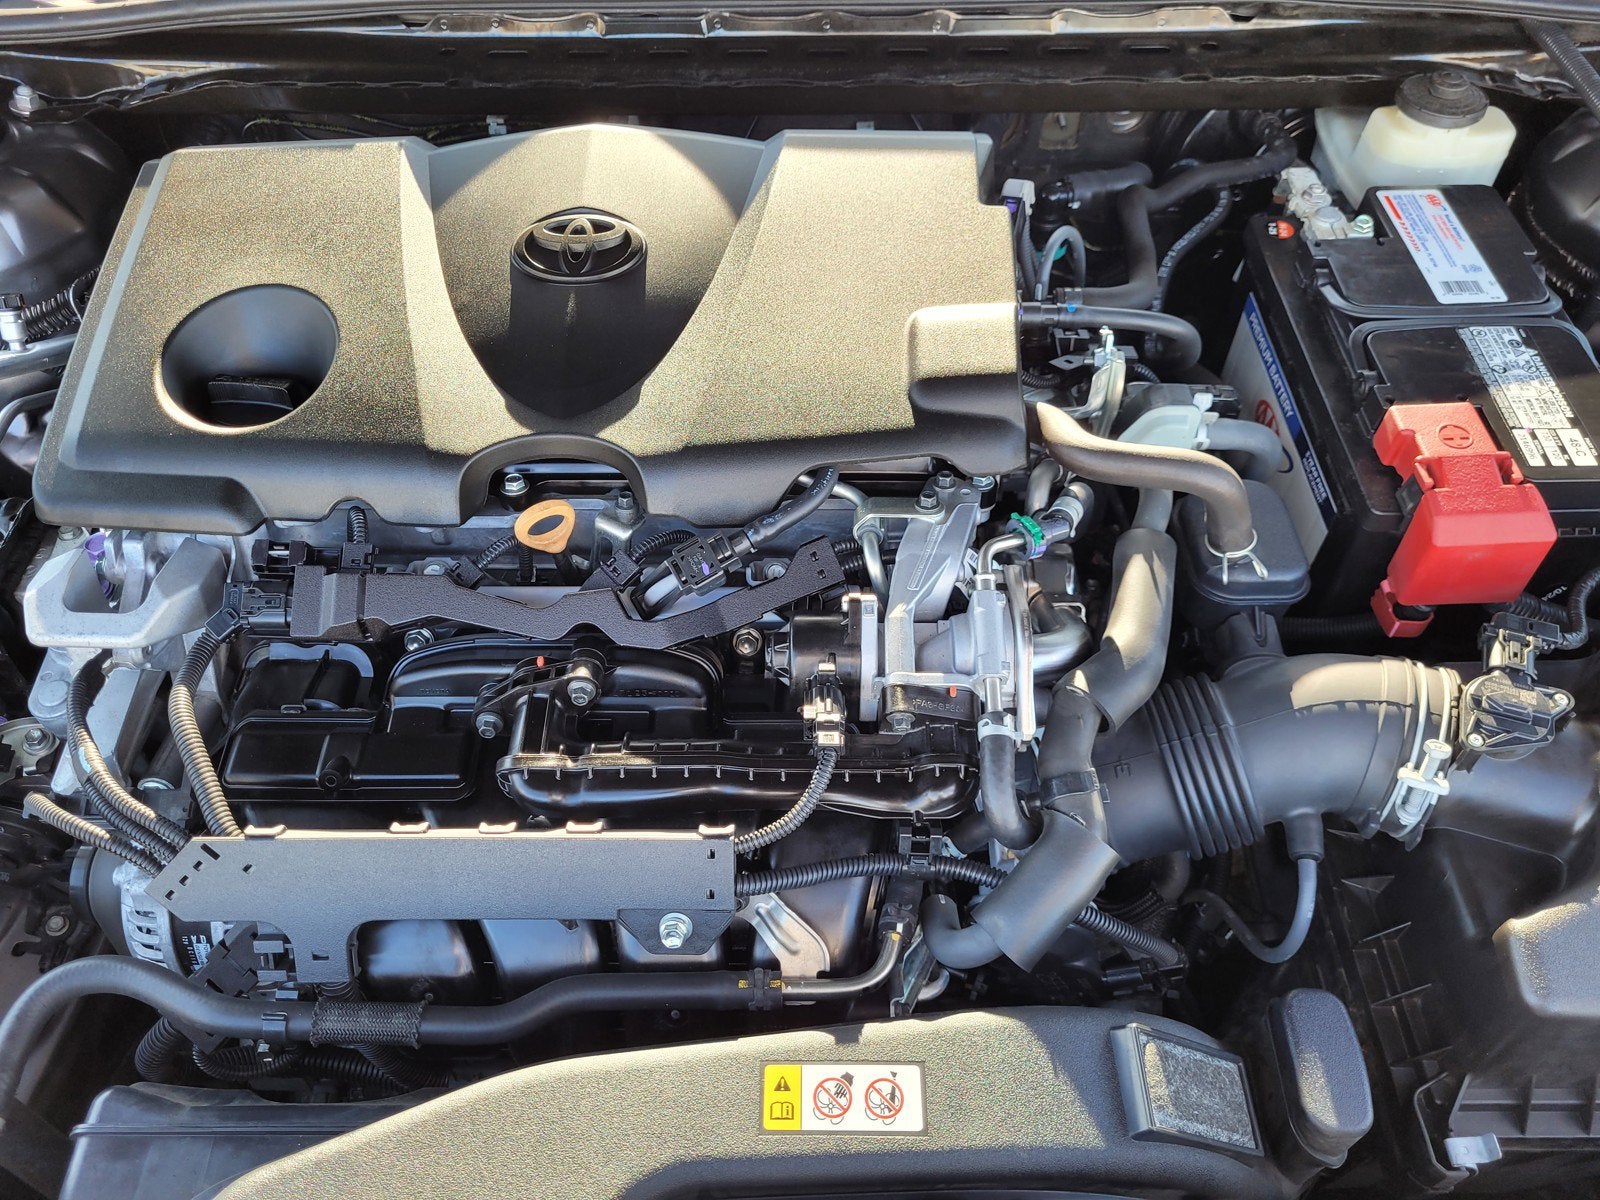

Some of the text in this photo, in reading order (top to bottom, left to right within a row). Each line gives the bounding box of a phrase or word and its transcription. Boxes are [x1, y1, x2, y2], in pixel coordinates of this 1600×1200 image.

[1249, 312, 1294, 417] PREMIUM BATTERY
[1570, 438, 1587, 457] 48-C
